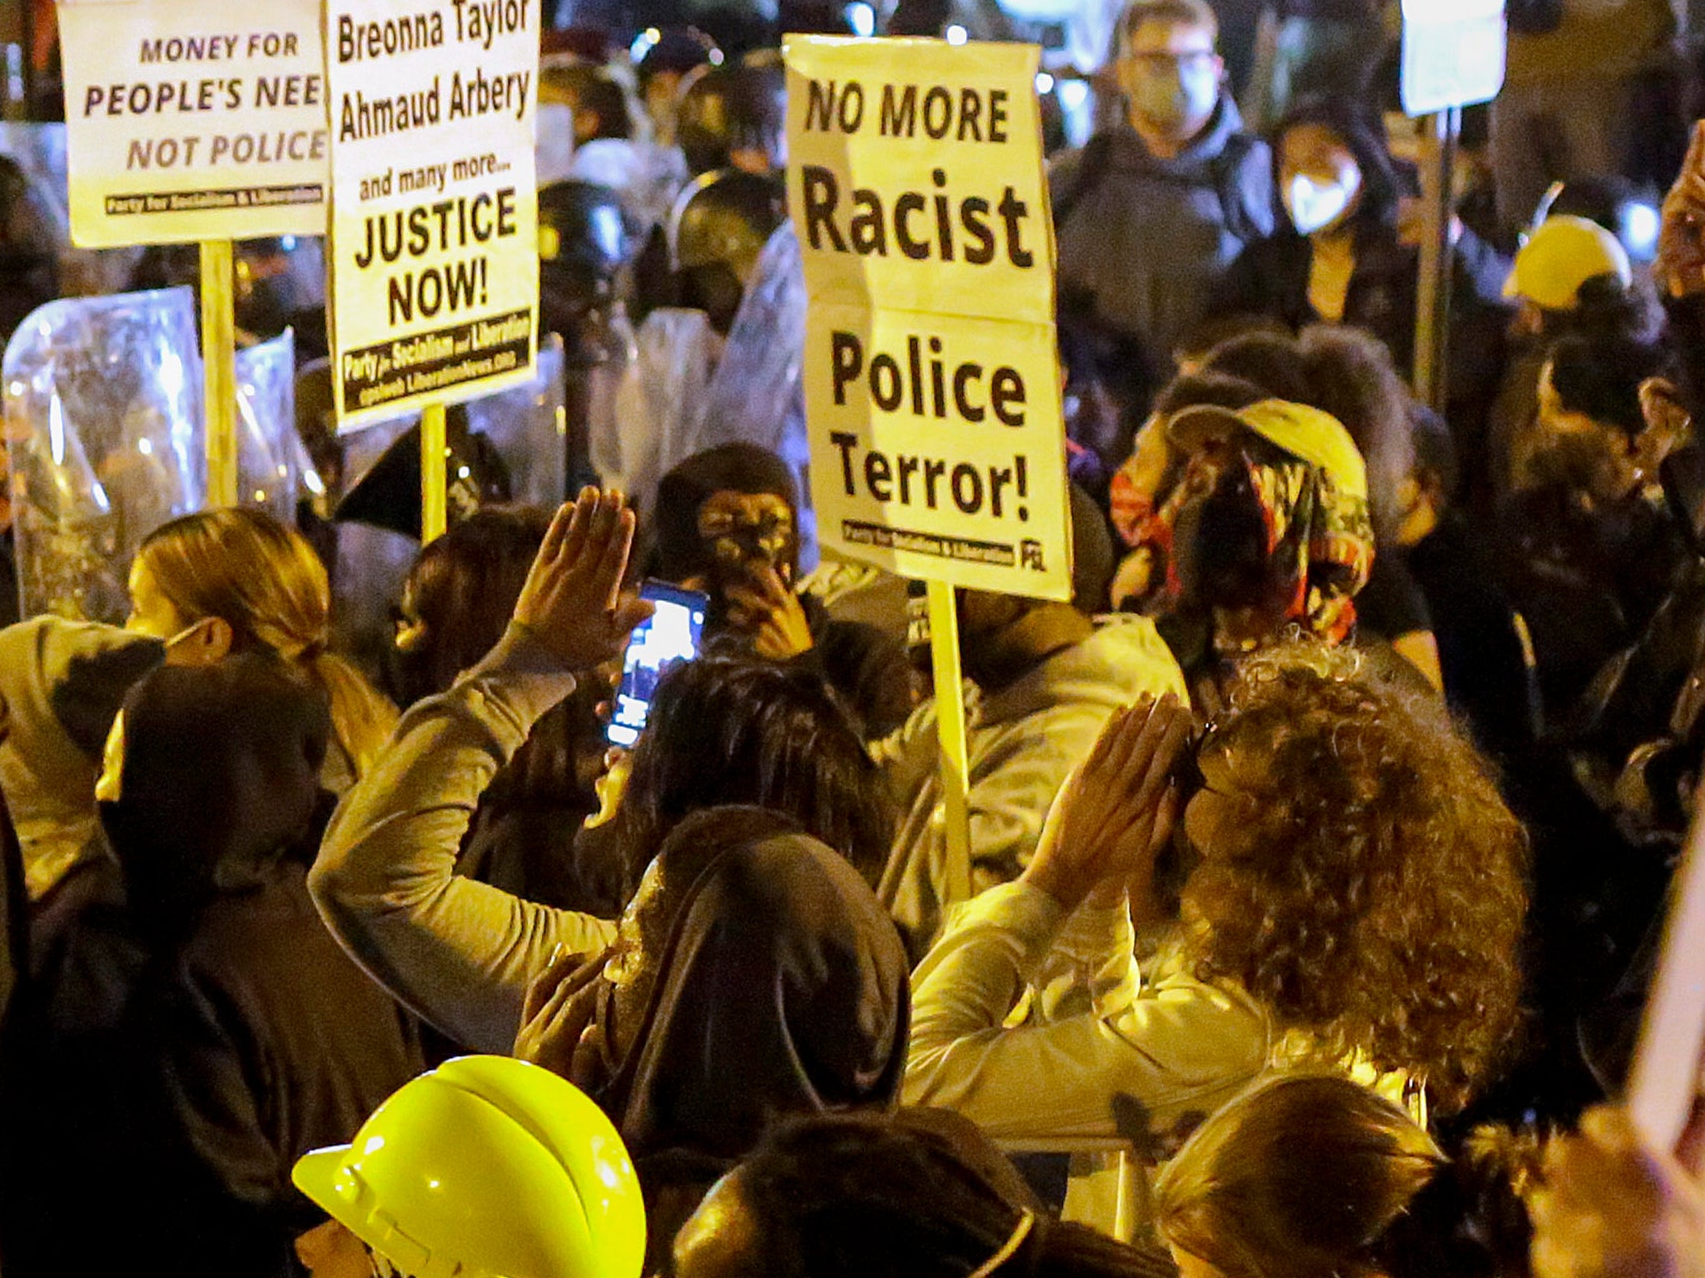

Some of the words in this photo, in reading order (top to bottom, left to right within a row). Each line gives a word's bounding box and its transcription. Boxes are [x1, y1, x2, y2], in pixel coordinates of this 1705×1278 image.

[140, 34, 237, 63] MONEY
[248, 32, 299, 57] FOR
[338, 10, 443, 64] Breonna
[84, 79, 242, 117] PEOPLE'S
[255, 74, 321, 107] NEE
[340, 75, 440, 142] Ahmaud
[449, 67, 530, 121] Arbery
[805, 79, 863, 135] NO
[880, 84, 1008, 143] MORE
[126, 136, 199, 171] NOT
[210, 130, 326, 166] POLICE
[360, 167, 393, 201] and
[399, 162, 447, 193] many
[355, 187, 516, 270] JUSTICE
[801, 165, 1034, 269] Racist
[389, 256, 487, 326] NOW!
[831, 331, 1027, 427] Police
[830, 431, 1029, 522] Terror!
